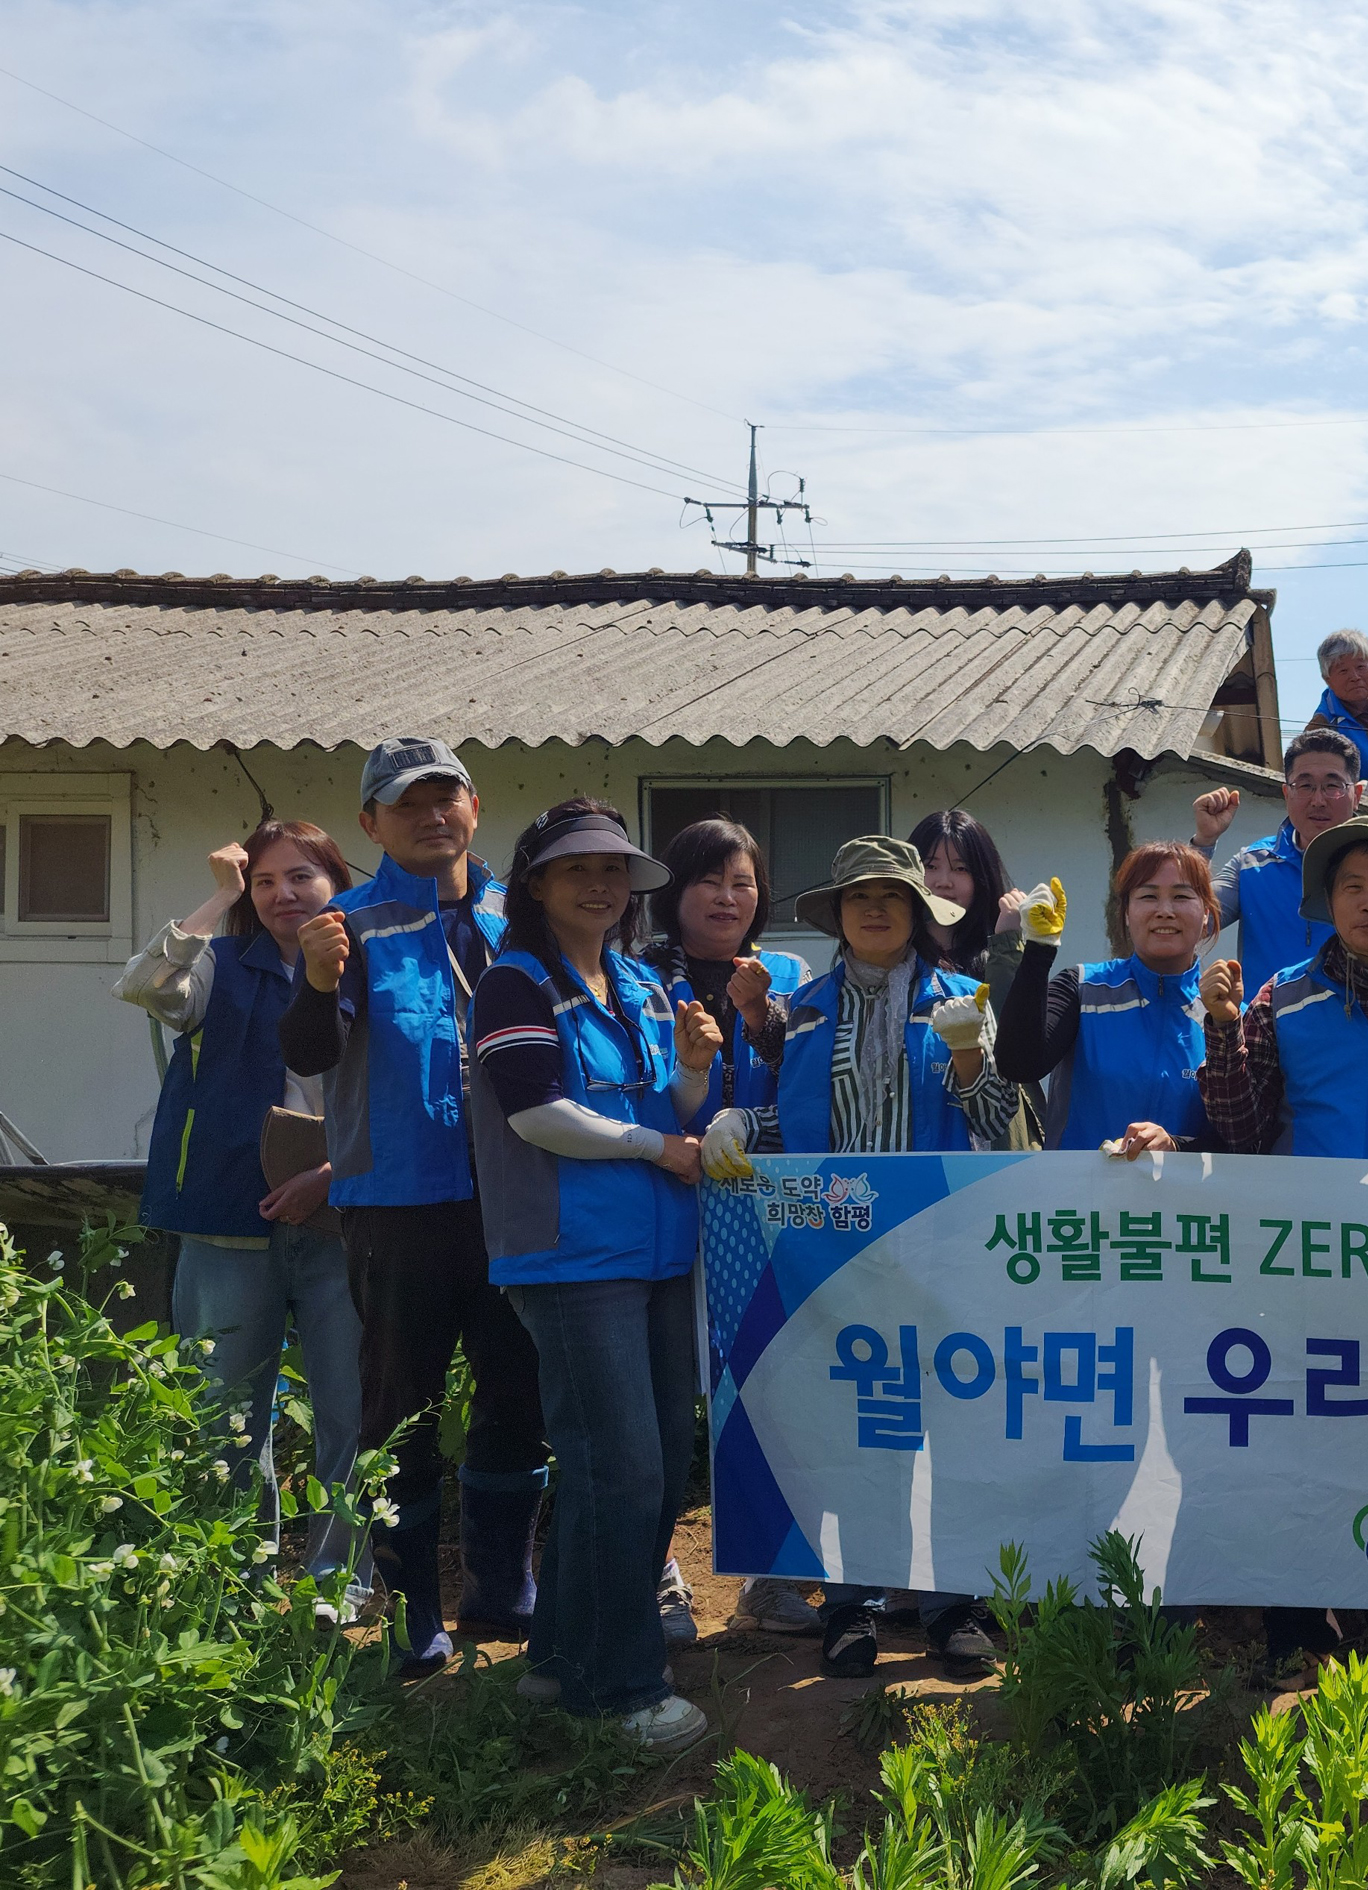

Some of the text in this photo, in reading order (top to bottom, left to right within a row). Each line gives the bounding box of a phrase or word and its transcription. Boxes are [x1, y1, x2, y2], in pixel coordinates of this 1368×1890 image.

[720, 1175, 822, 1200] 새로운 도약
[767, 1203, 870, 1229] 희망찬 함평
[985, 1210, 1232, 1284] 생활불편
[829, 1324, 1135, 1462] 월야면
